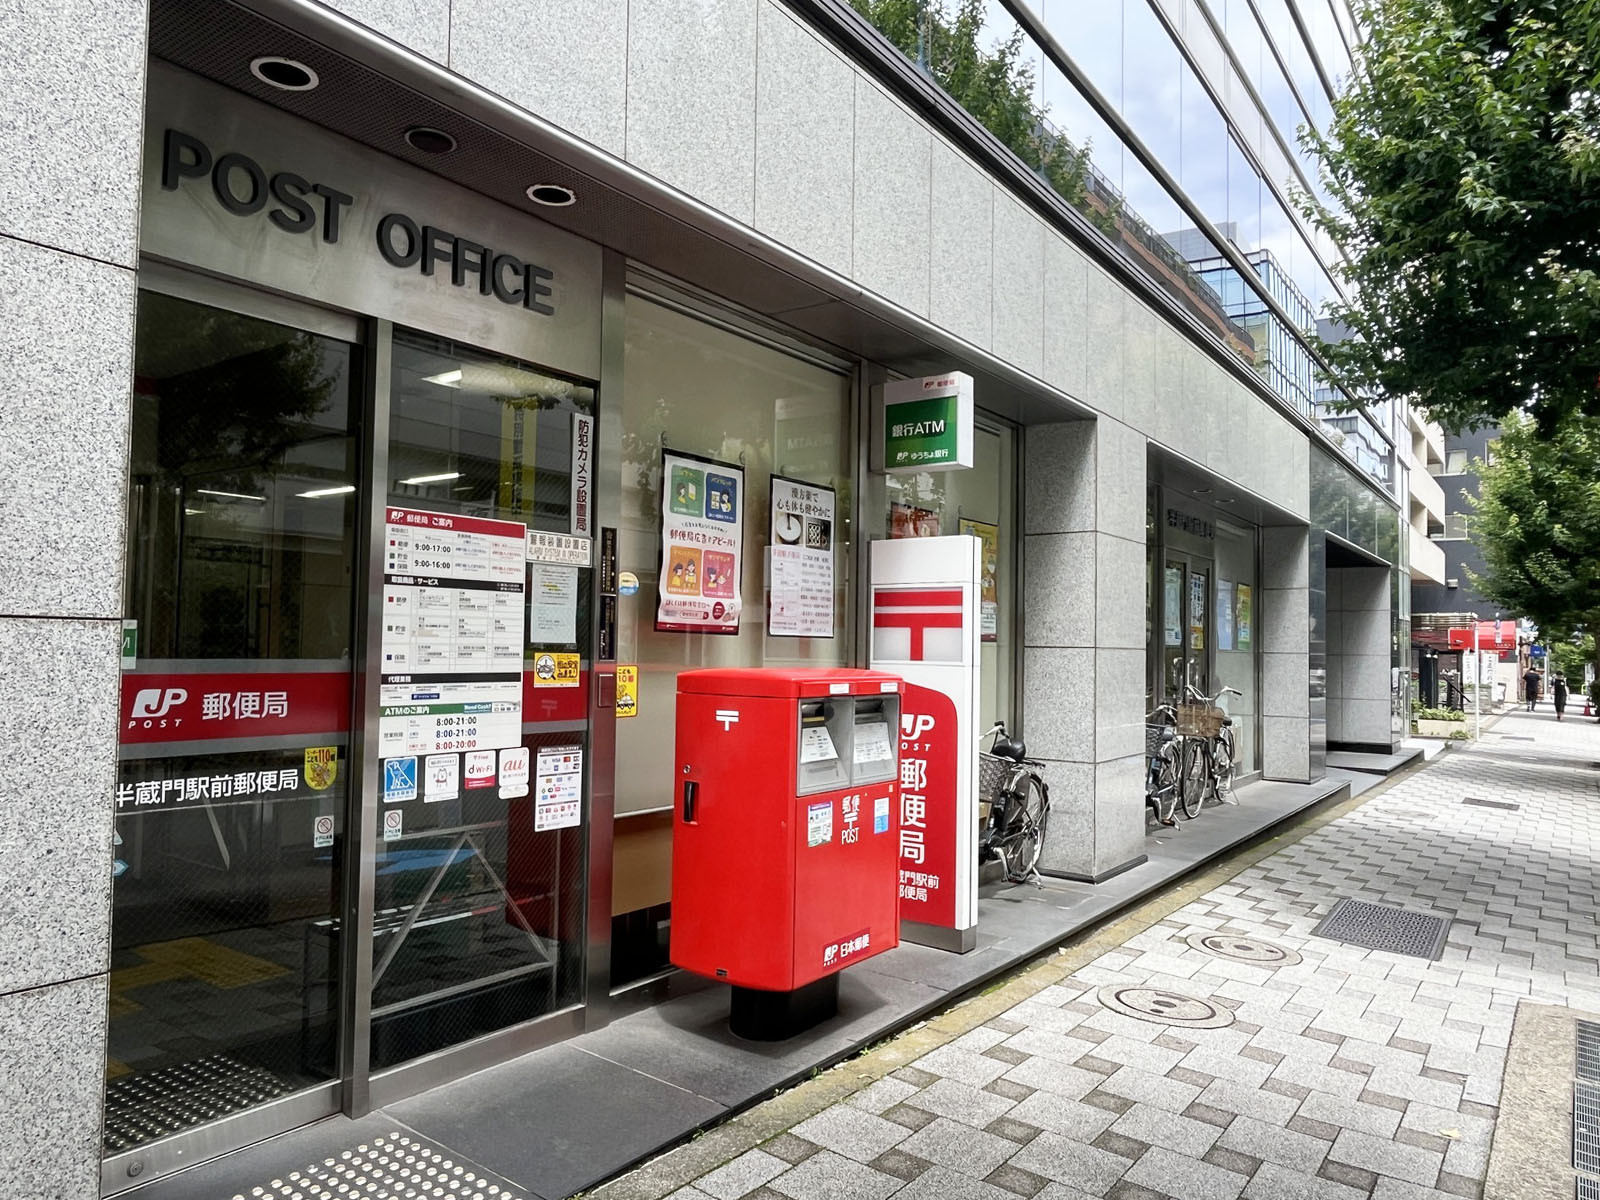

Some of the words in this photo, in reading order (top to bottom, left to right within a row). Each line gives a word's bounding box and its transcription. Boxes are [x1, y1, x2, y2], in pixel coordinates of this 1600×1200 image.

[161, 128, 353, 244] POST
[377, 212, 554, 316] OFFICE
[891, 419, 945, 438] 銀行ATM
[910, 448, 949, 461] ゆうちょ銀行
[575, 418, 590, 532] 防犯カメラ設置局
[776, 499, 831, 518] 心も体も健やかに
[406, 514, 429, 525] 郵便局
[431, 517, 453, 528] ご案内
[415, 544, 451, 553] 9:00-17:00
[414, 560, 451, 569] 9:00-16:00
[130, 687, 188, 719] JP
[201, 691, 289, 721] 郵便局
[384, 706, 430, 716] ATMのご案内
[128, 718, 183, 729] POST
[436, 716, 477, 726] 8:00-21:00
[435, 727, 477, 738] 8:00-21:00
[435, 739, 477, 750] 8:00-20:00
[900, 742, 931, 752] OST
[503, 759, 523, 772] au
[116, 768, 299, 808] 半蔵門駅前郵便局
[842, 794, 861, 815] 郵便
[899, 757, 927, 865] 郵便局
[841, 827, 860, 845] POST
[840, 933, 870, 958] 日本郵便
